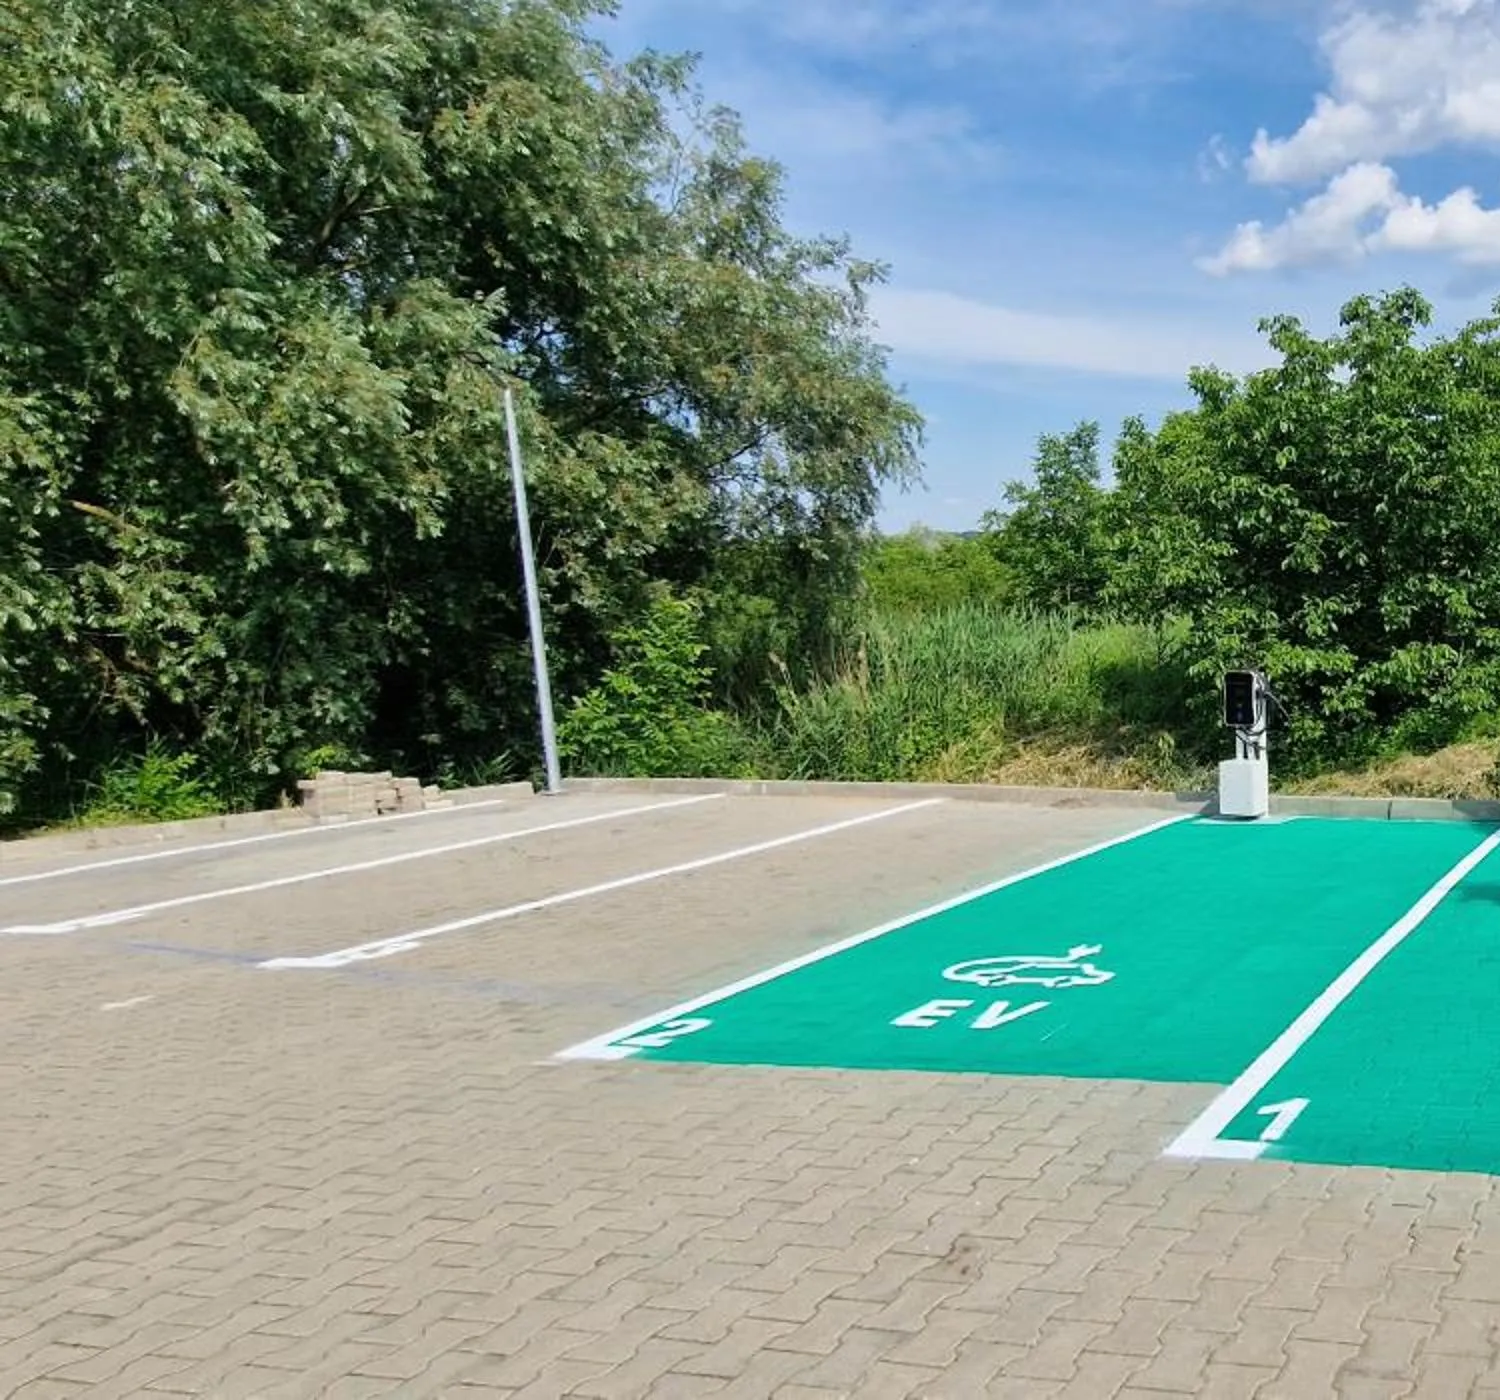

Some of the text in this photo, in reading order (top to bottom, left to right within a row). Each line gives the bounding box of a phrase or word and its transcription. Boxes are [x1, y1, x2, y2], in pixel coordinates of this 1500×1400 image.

[889, 1000, 1052, 1029] EV
[614, 1017, 714, 1047] 2
[1256, 1097, 1311, 1141] 1
